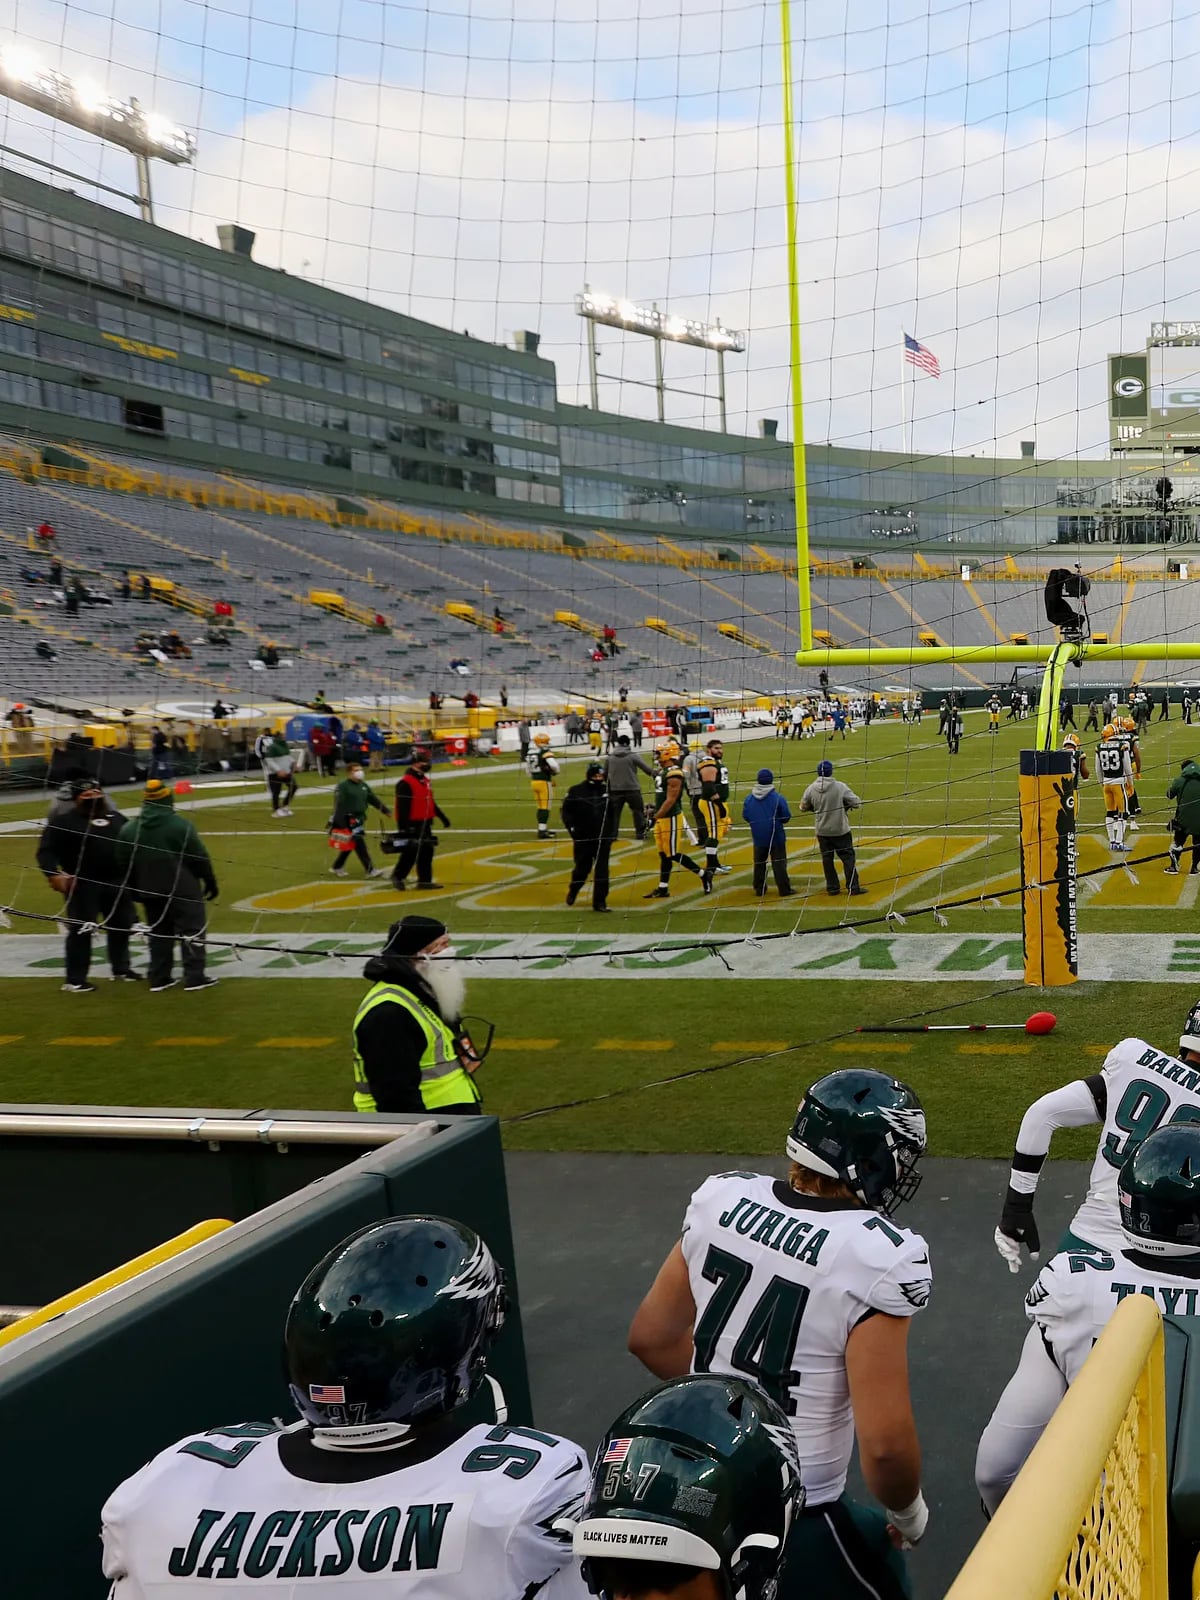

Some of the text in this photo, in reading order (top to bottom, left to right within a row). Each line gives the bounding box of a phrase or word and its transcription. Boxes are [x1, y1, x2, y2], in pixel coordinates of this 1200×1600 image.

[1117, 425, 1143, 442] Lite
[1099, 750, 1121, 771] 83
[1067, 831, 1079, 963] MY CAUSE MY CLEATS
[718, 1197, 831, 1267] JURIGA
[1144, 1244, 1166, 1252] MATTER
[692, 1243, 812, 1418] 74
[326, 1401, 368, 1427] 97
[361, 1428, 389, 1437] MATTER
[167, 1501, 454, 1580] JACKSON
[583, 1530, 669, 1546] BLACK LIVES MATTER
